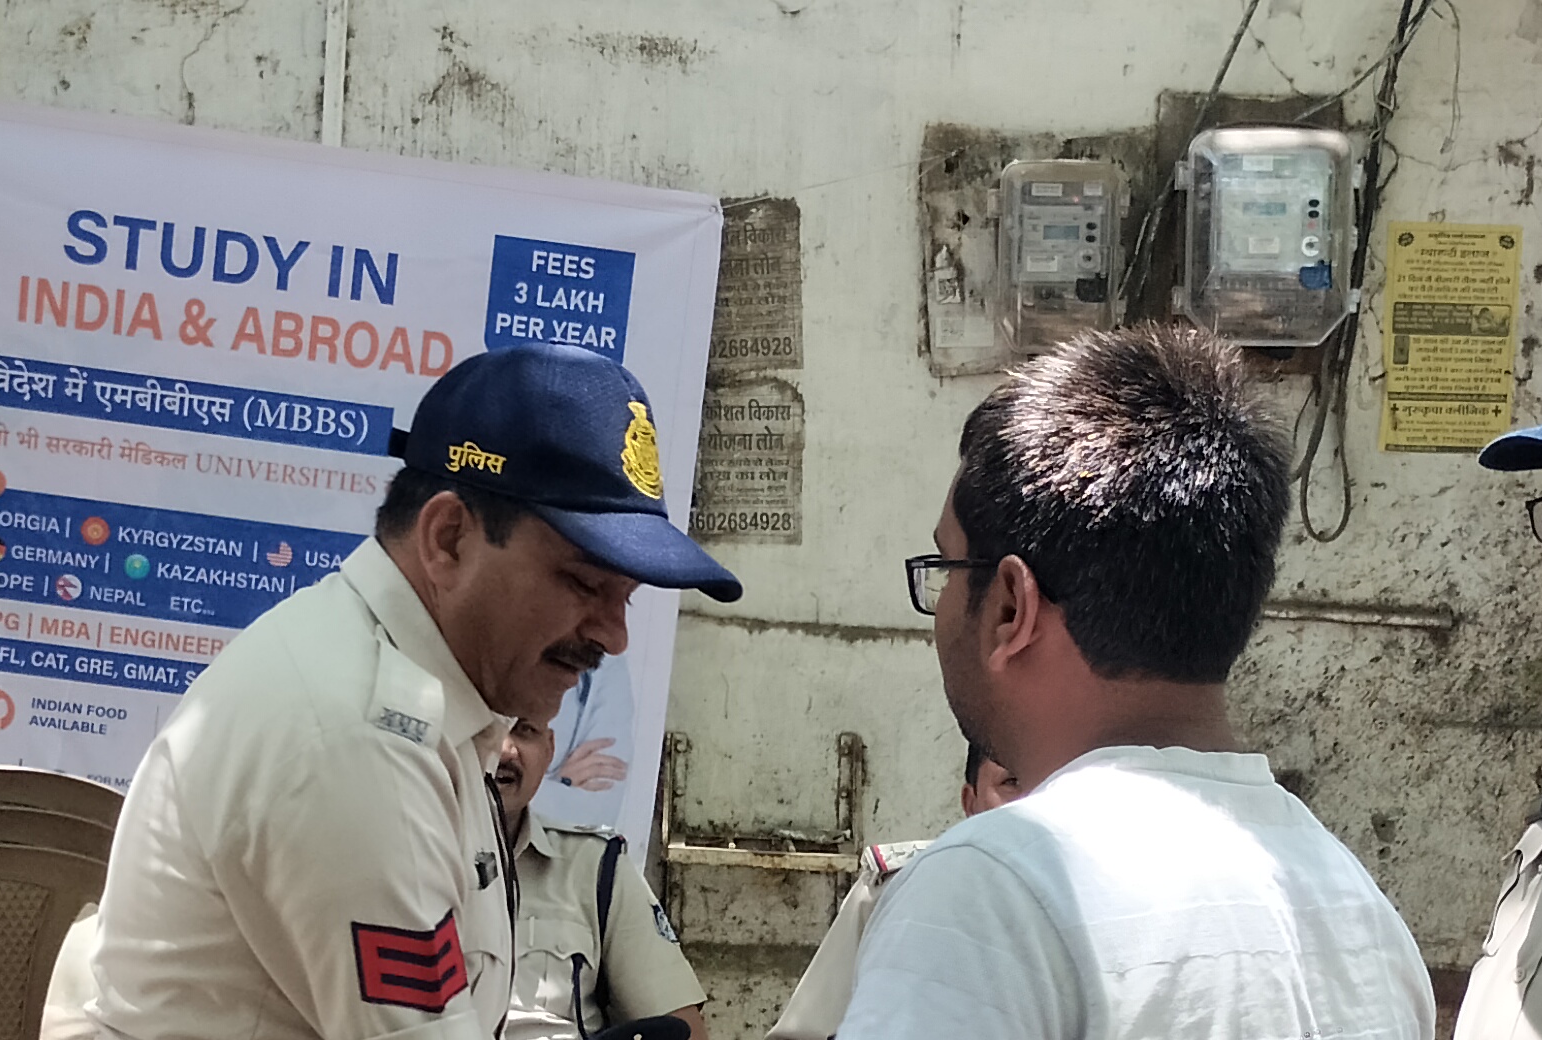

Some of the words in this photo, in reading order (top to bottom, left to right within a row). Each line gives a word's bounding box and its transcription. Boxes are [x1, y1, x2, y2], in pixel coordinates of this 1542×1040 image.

[63, 209, 311, 292] STUDY
[327, 244, 399, 306] IN
[531, 250, 596, 279] FEES
[514, 282, 528, 304] 3
[536, 284, 605, 314] LAKH
[17, 275, 163, 342] INDIA
[178, 297, 218, 348] &
[230, 306, 455, 377] ABROAD
[495, 312, 544, 340] PER
[552, 319, 617, 349] YEAR
[64, 366, 89, 403] में
[94, 380, 234, 426] एमबीबीएस
[242, 395, 370, 444] (MBBS)
[748, 399, 791, 421] विकास
[709, 424, 753, 450] योजना
[756, 425, 785, 450] लोन
[16, 427, 40, 450] भी
[45, 436, 114, 461] सरकारी
[119, 439, 188, 470] मेडिकल
[196, 453, 377, 495] UNIVERSITIES
[446, 441, 507, 475] पुलिस
[117, 526, 243, 558] KYRGYZSTAN
[305, 551, 342, 569] USA
[11, 545, 100, 570] GERMANY
[157, 562, 284, 593] KAZAKHSTAN
[89, 585, 146, 607] NEPAL
[40, 616, 91, 641] MBA
[110, 626, 229, 656] ENGINEER
[31, 651, 70, 673] CAT,
[75, 657, 118, 679] GRE,
[123, 663, 180, 687] GMAT,
[29, 715, 107, 735] AVAILABLE
[31, 697, 82, 714] INDIAN
[86, 705, 127, 720] FOOD
